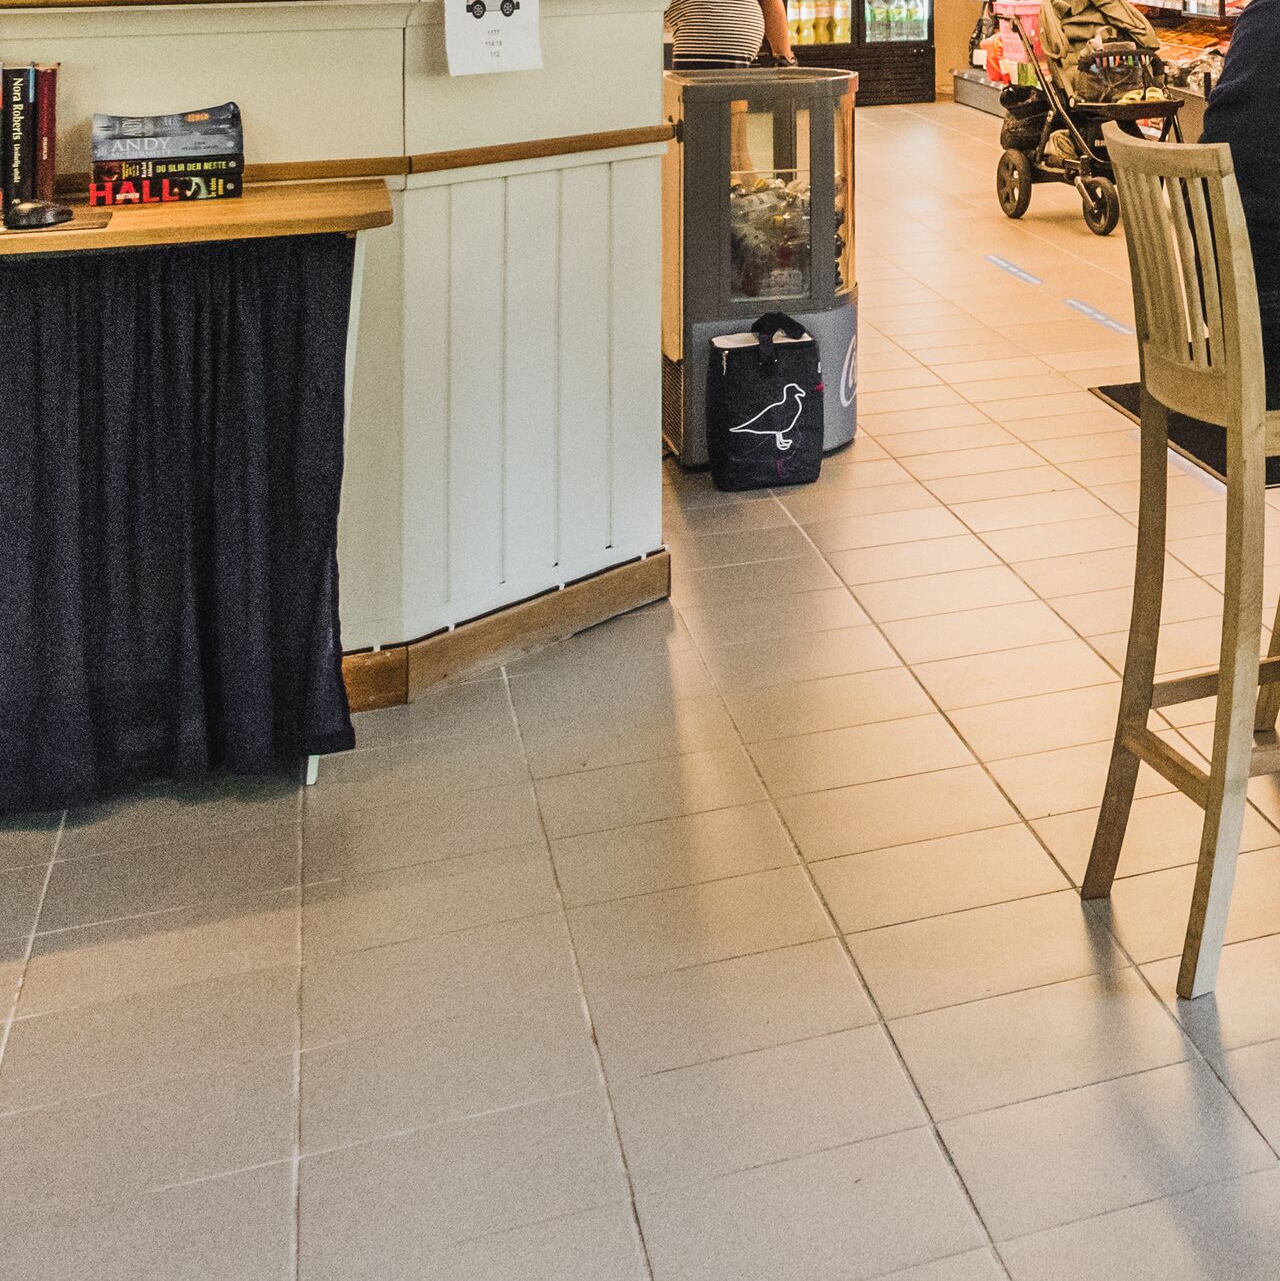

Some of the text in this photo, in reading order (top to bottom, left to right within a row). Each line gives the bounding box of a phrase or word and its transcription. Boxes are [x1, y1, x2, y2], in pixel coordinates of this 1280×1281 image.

[12, 77, 24, 102] Nora
[12, 103, 25, 140] Roberts
[112, 137, 172, 152] ANDY
[89, 178, 180, 207] HALL
